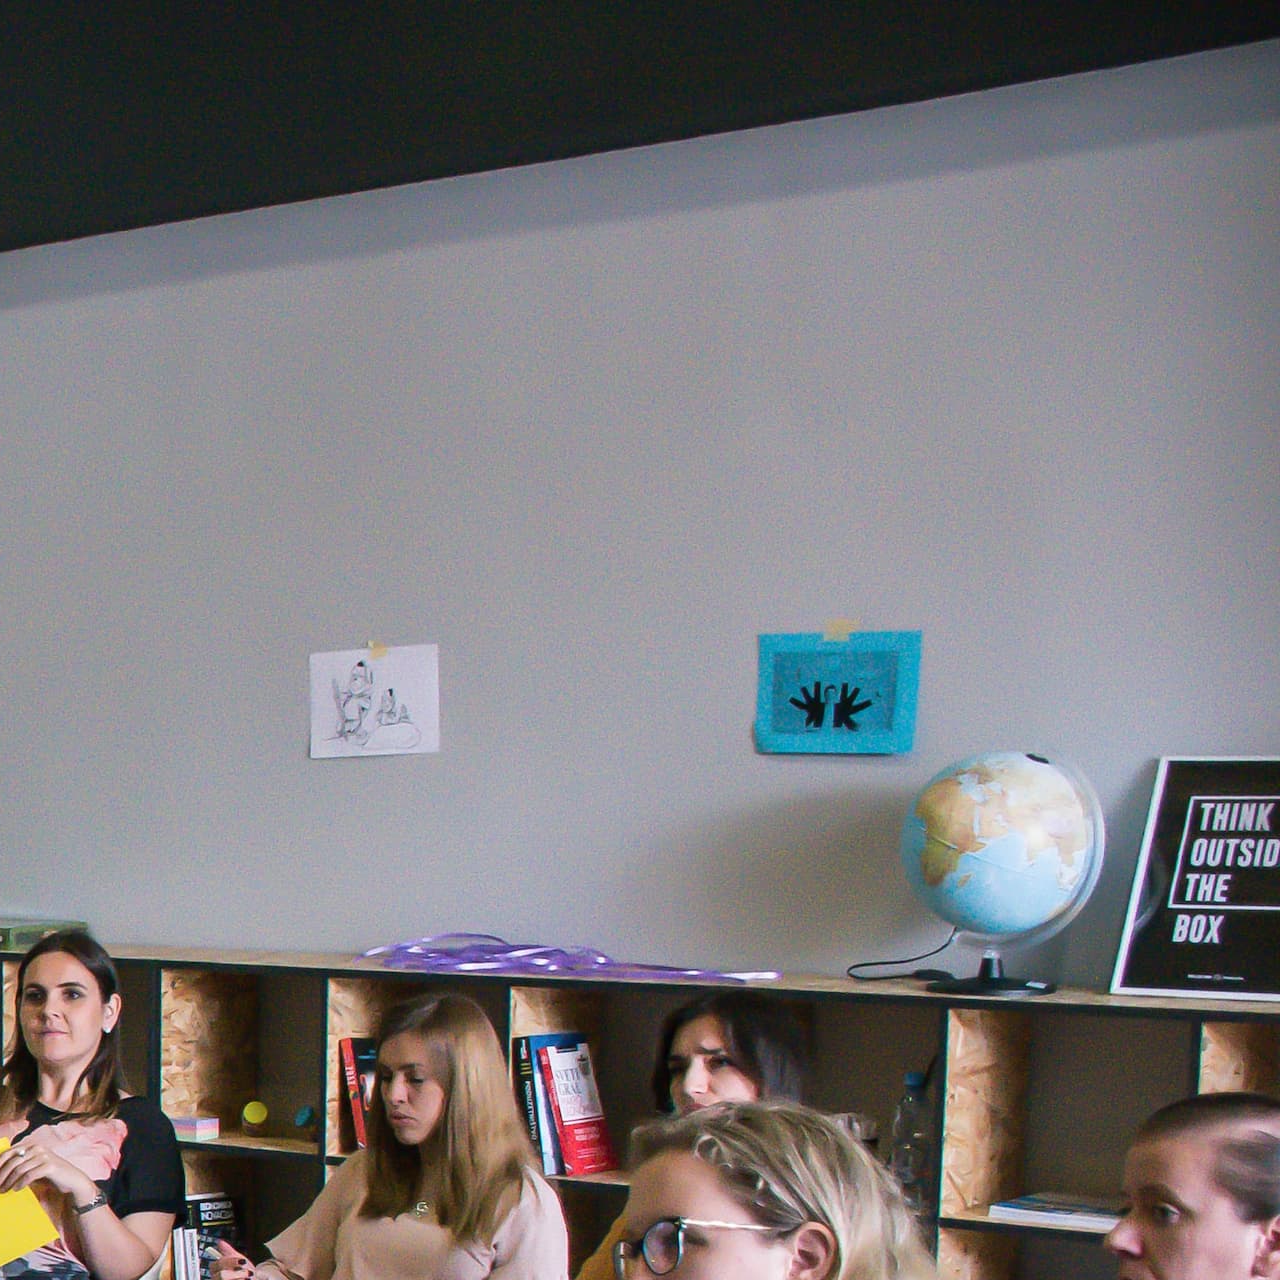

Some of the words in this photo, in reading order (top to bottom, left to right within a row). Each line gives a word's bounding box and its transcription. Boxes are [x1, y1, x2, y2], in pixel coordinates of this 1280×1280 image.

[1200, 802, 1275, 832] THINK
[1190, 838, 1280, 868] OUTSID
[1185, 873, 1232, 903] THE
[1172, 914, 1225, 944] BOX
